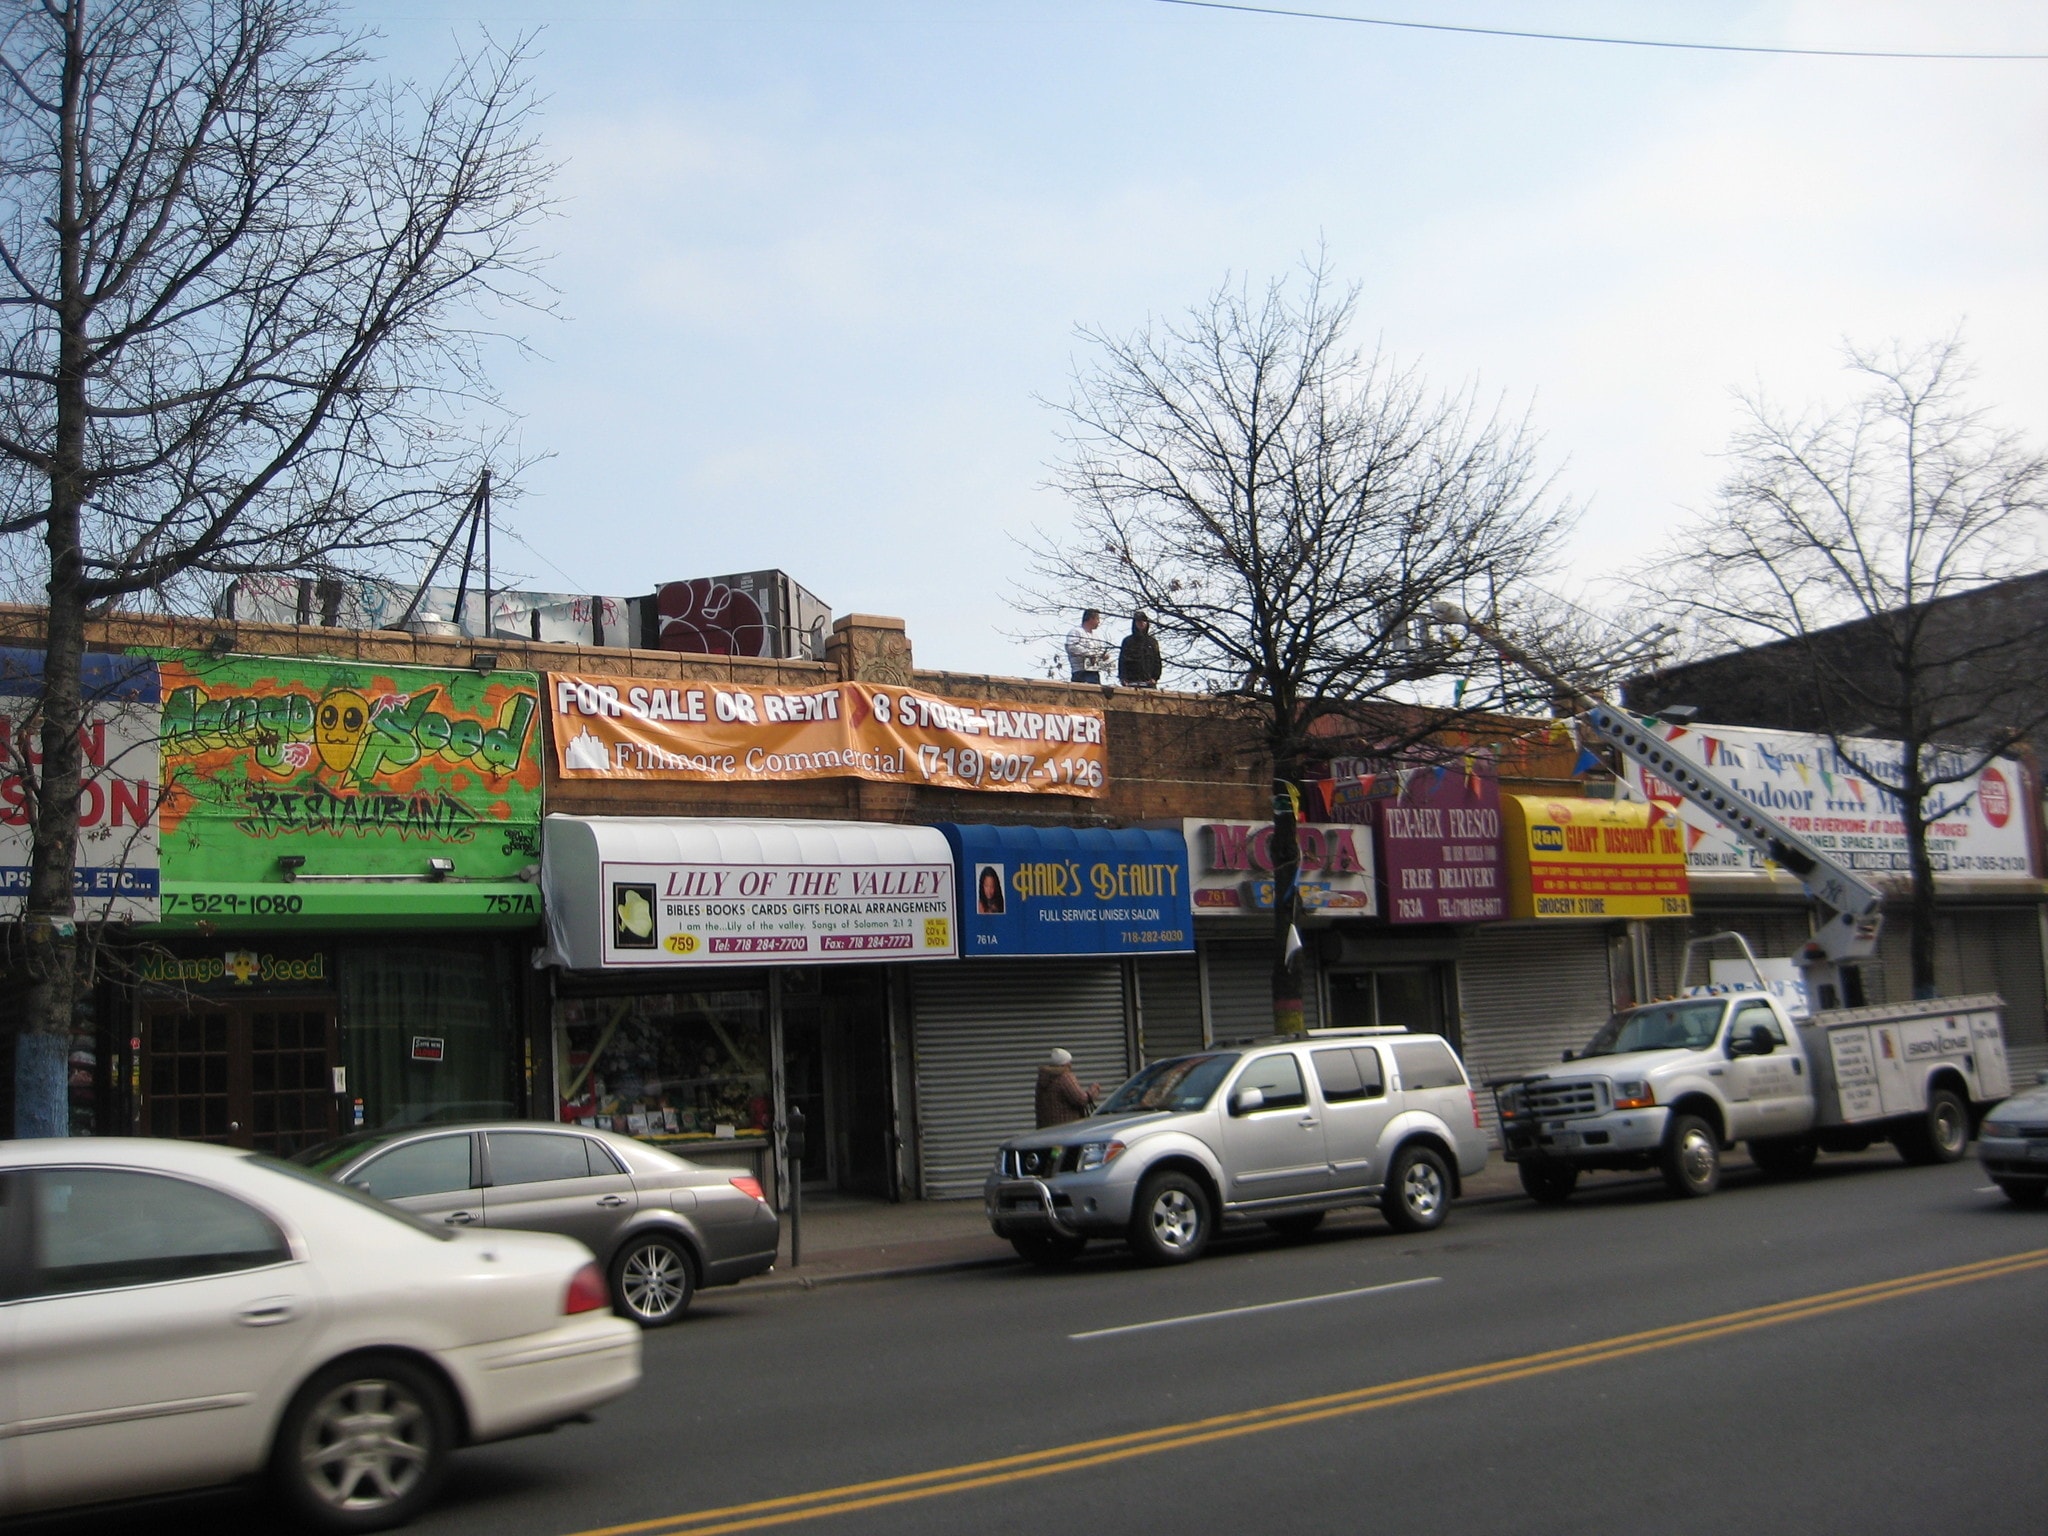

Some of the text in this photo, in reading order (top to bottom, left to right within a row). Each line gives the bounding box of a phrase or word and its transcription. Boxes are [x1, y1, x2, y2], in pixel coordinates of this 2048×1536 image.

[558, 682, 620, 716] FOR
[629, 687, 707, 722] SALE
[716, 691, 758, 723] OR
[763, 690, 839, 723] RENT
[873, 693, 890, 723] 8
[340, 688, 538, 789] Seed
[614, 742, 1103, 788] Fillmore Commercial (718) 907-1126
[246, 781, 475, 834] RESTAURANT
[1385, 808, 1498, 838] TEX-MEX FRESCO
[1789, 817, 1811, 830] FOR
[1813, 817, 1867, 834] EVERYONE
[1935, 823, 1968, 837] PRICES
[1211, 824, 1366, 873] MODA
[1567, 826, 1599, 853] GIANT
[1603, 826, 1655, 854] DISCOUNT
[1660, 828, 1681, 854] INC.
[1840, 835, 1873, 850] SPACE
[1877, 836, 1889, 849] 24
[1852, 852, 1892, 869] UNDER
[664, 870, 947, 897] LILY OF THE VALLEY
[1012, 859, 1180, 901] HAIR'S BEAUTY
[1401, 867, 1496, 889] FREE DELIVERY
[483, 894, 535, 914] 757A
[1207, 890, 1227, 902] 761
[1538, 897, 1575, 914] GROCERY
[1578, 897, 1605, 914] STORE
[667, 901, 947, 916] BIBLES BOOKS CARDS GIFTS FLORAL ARRANGEMENTS
[1039, 908, 1159, 922] FULL SERVICE UNISEX SALON
[1397, 897, 1424, 918] 763A
[679, 921, 683, 931] I
[747, 920, 756, 931] of
[760, 920, 773, 931] the
[779, 919, 806, 933] valley.
[812, 920, 837, 931] Songs
[841, 919, 850, 929] of
[854, 919, 889, 929] Solomon
[669, 936, 694, 950] 759
[714, 938, 805, 951] Tel: 718 284-7700
[824, 935, 911, 949] Fax: 718 284-7772
[976, 930, 1184, 945] 761A 718-282-6030
[139, 952, 324, 983] Mango Seed
